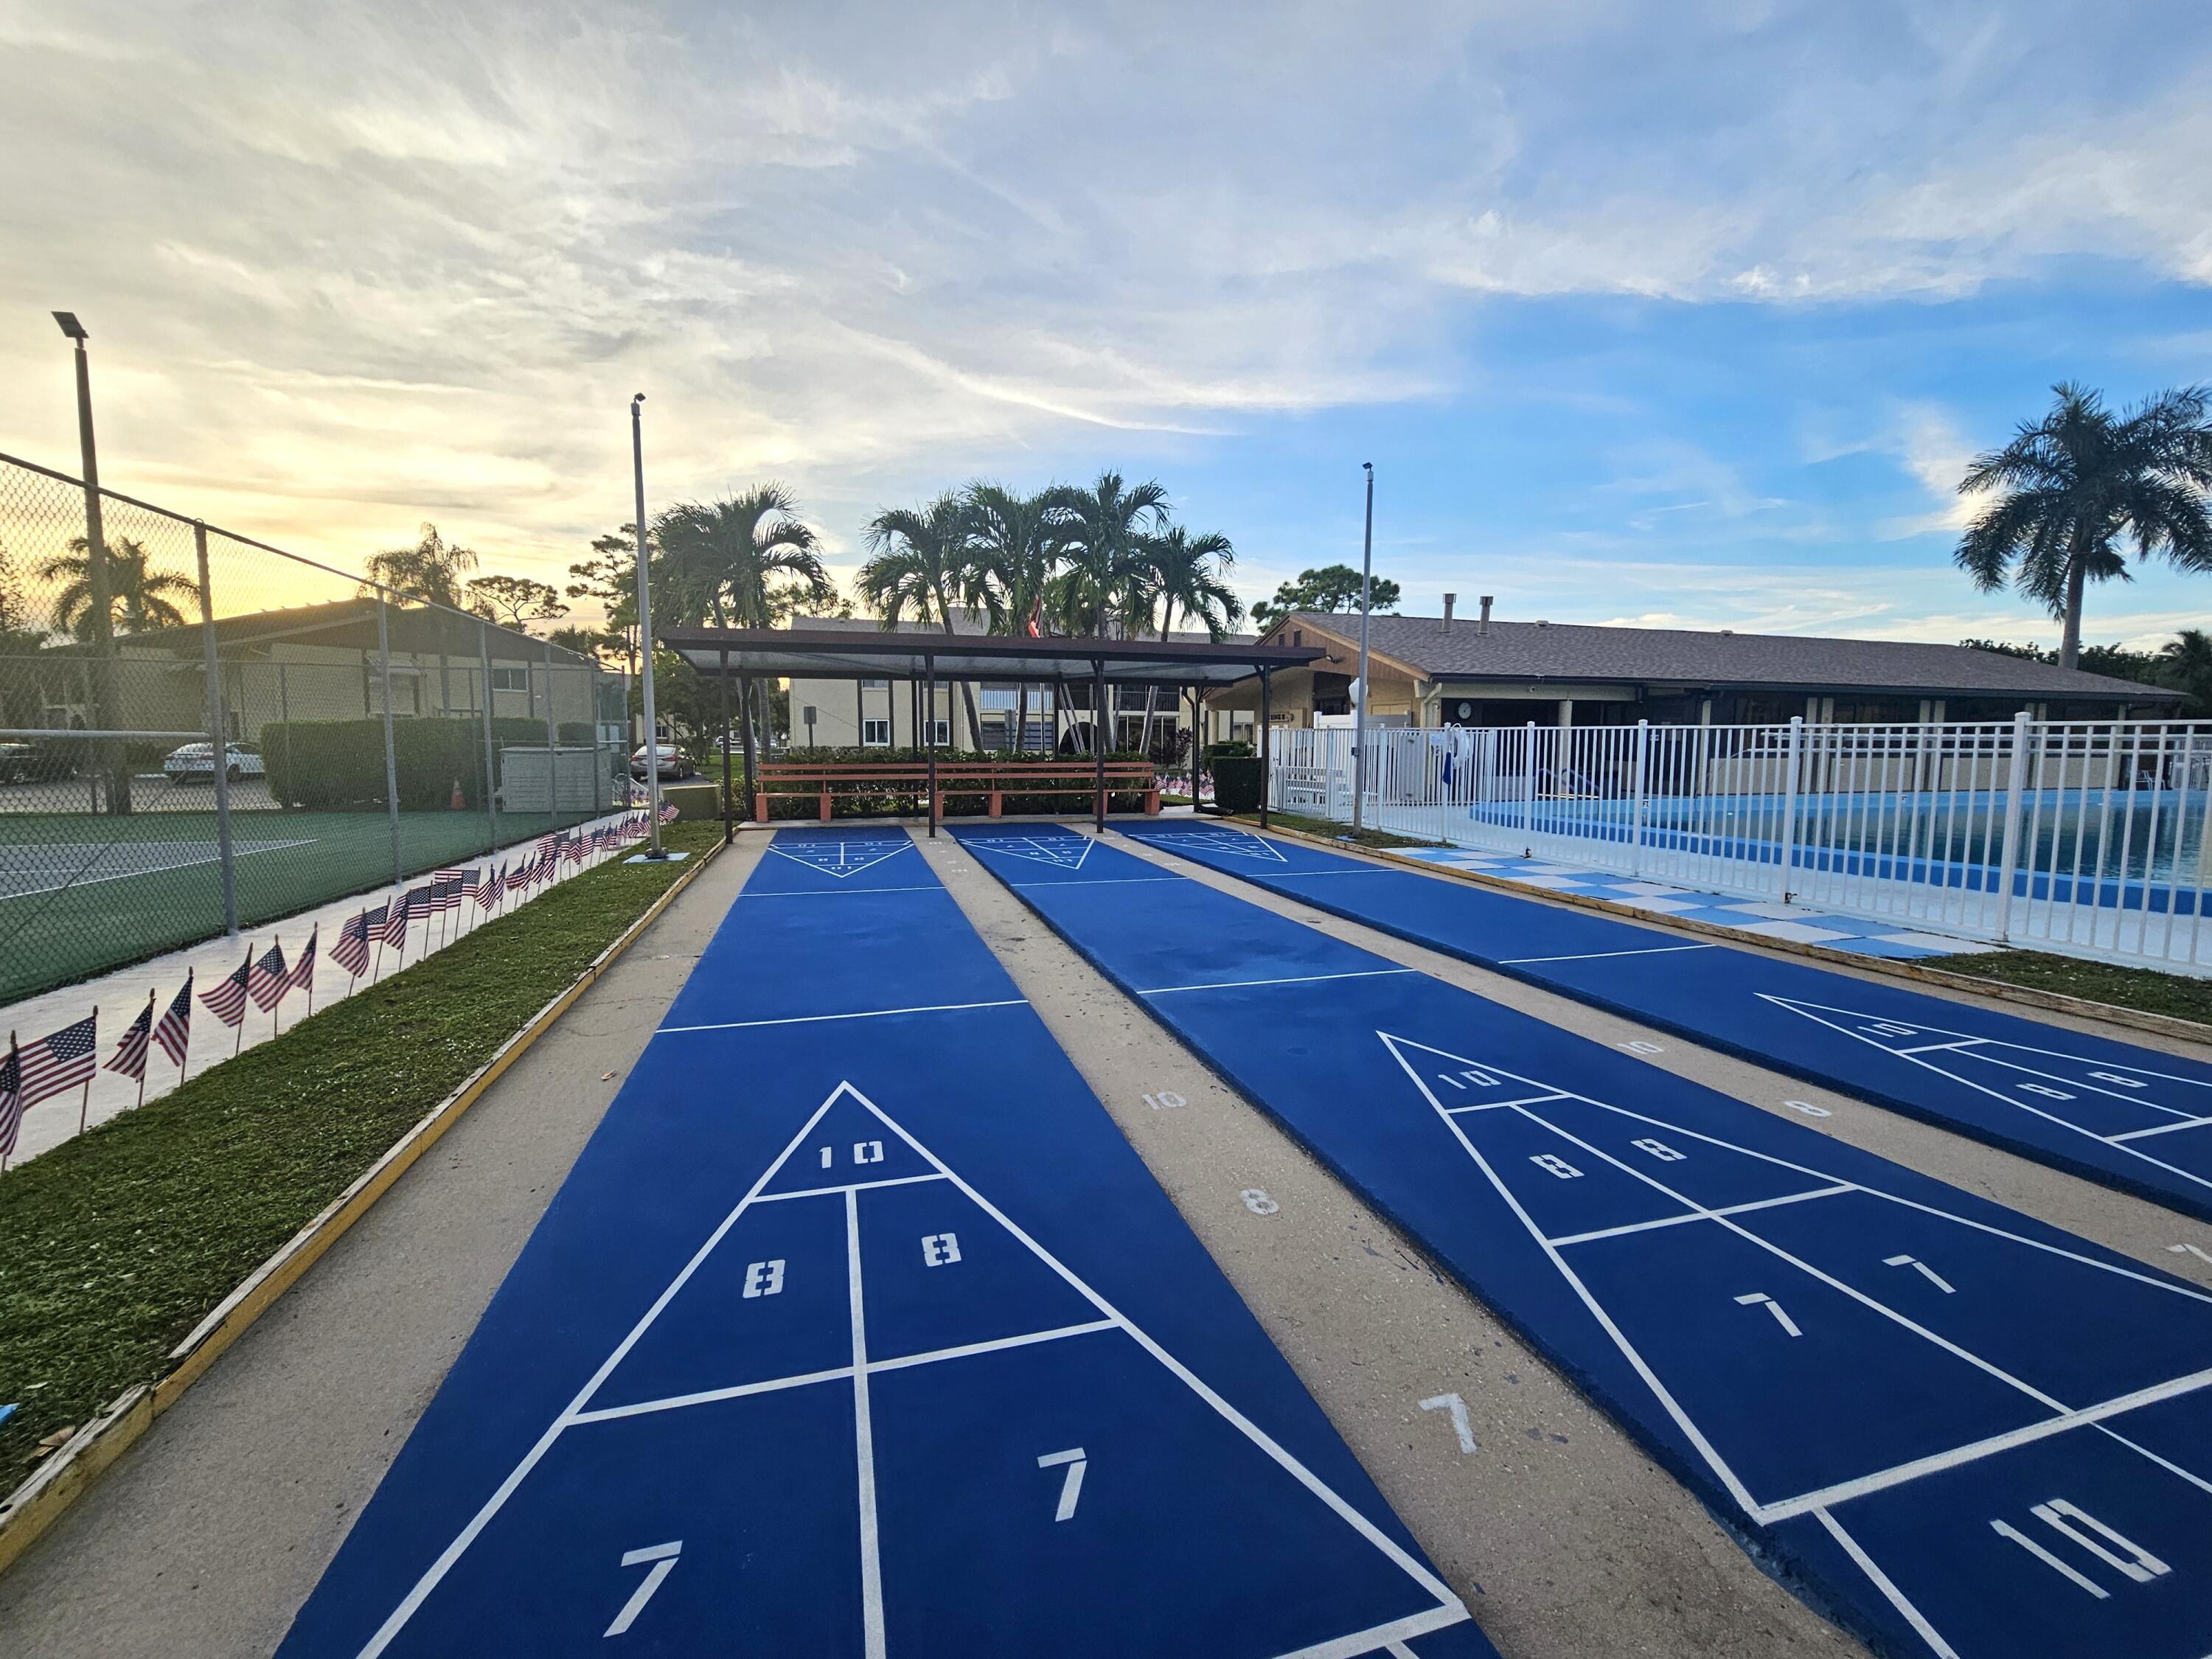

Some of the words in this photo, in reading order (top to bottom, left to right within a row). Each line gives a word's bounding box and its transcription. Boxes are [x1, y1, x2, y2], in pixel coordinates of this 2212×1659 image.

[1857, 1023, 1919, 1037] 10
[1617, 1041, 1664, 1054] 10
[1438, 1070, 1502, 1089] 10
[2015, 1083, 2077, 1101] 8
[2087, 1071, 2149, 1088] 8
[1144, 1092, 1186, 1110] 10
[1783, 1100, 1832, 1117] 8
[820, 1141, 883, 1168] 10
[1631, 1139, 1687, 1161] 8
[1529, 1155, 1584, 1178] 8
[1240, 1188, 1279, 1215] 8
[922, 1233, 961, 1266] 8
[743, 1259, 785, 1298] 8
[1882, 1255, 1955, 1293] 7
[1733, 1293, 1802, 1337] 7
[1417, 1393, 1478, 1454] 7
[1037, 1447, 1087, 1521] 7
[1990, 1499, 2171, 1599] 10
[603, 1541, 682, 1637] 7
